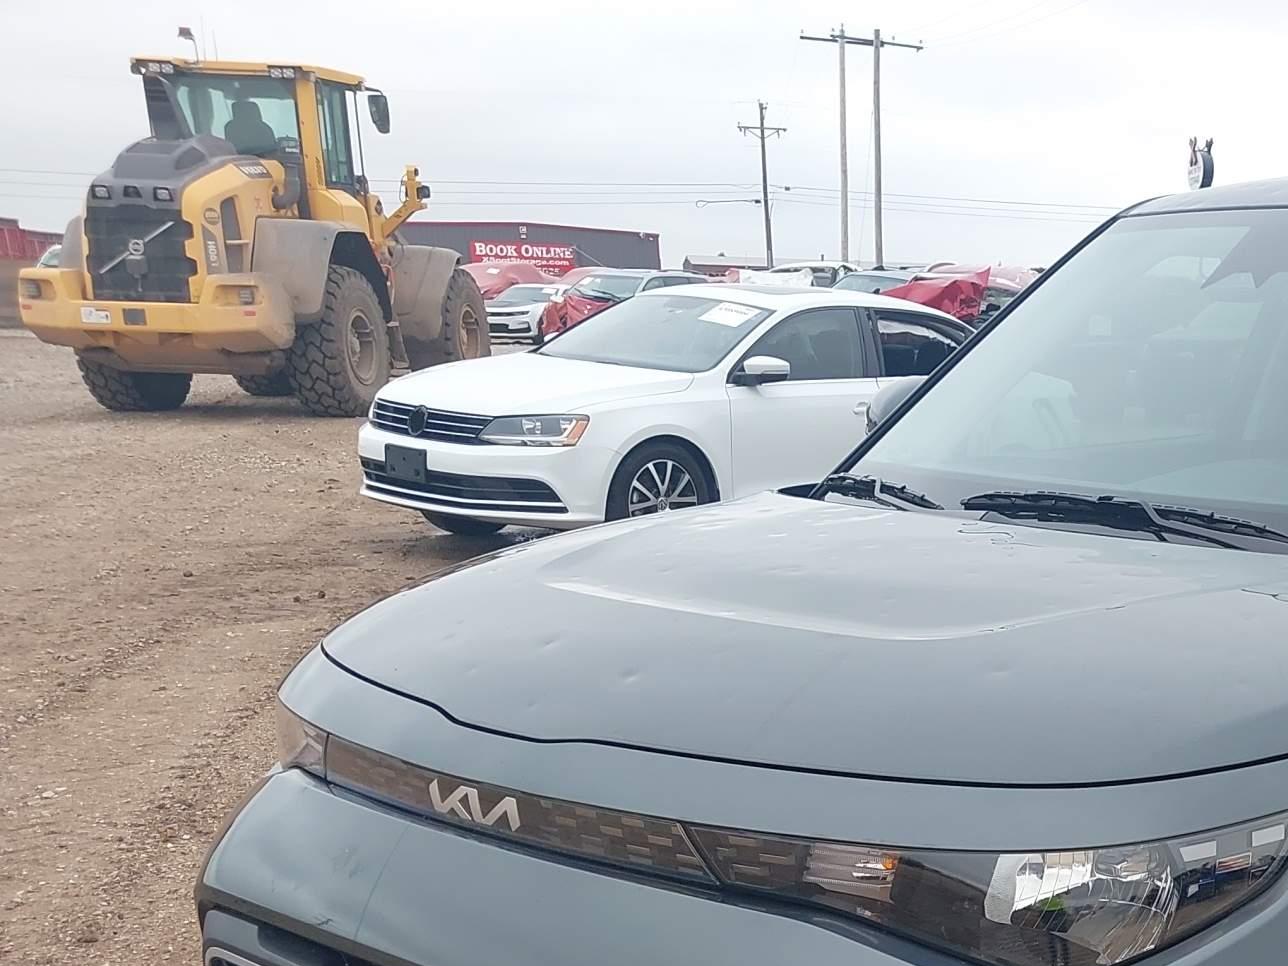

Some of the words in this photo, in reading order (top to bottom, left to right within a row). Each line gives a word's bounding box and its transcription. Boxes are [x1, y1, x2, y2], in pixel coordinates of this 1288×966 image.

[474, 242, 518, 257] BOOK
[521, 244, 574, 259] ONLINE
[428, 778, 521, 832] KIA
